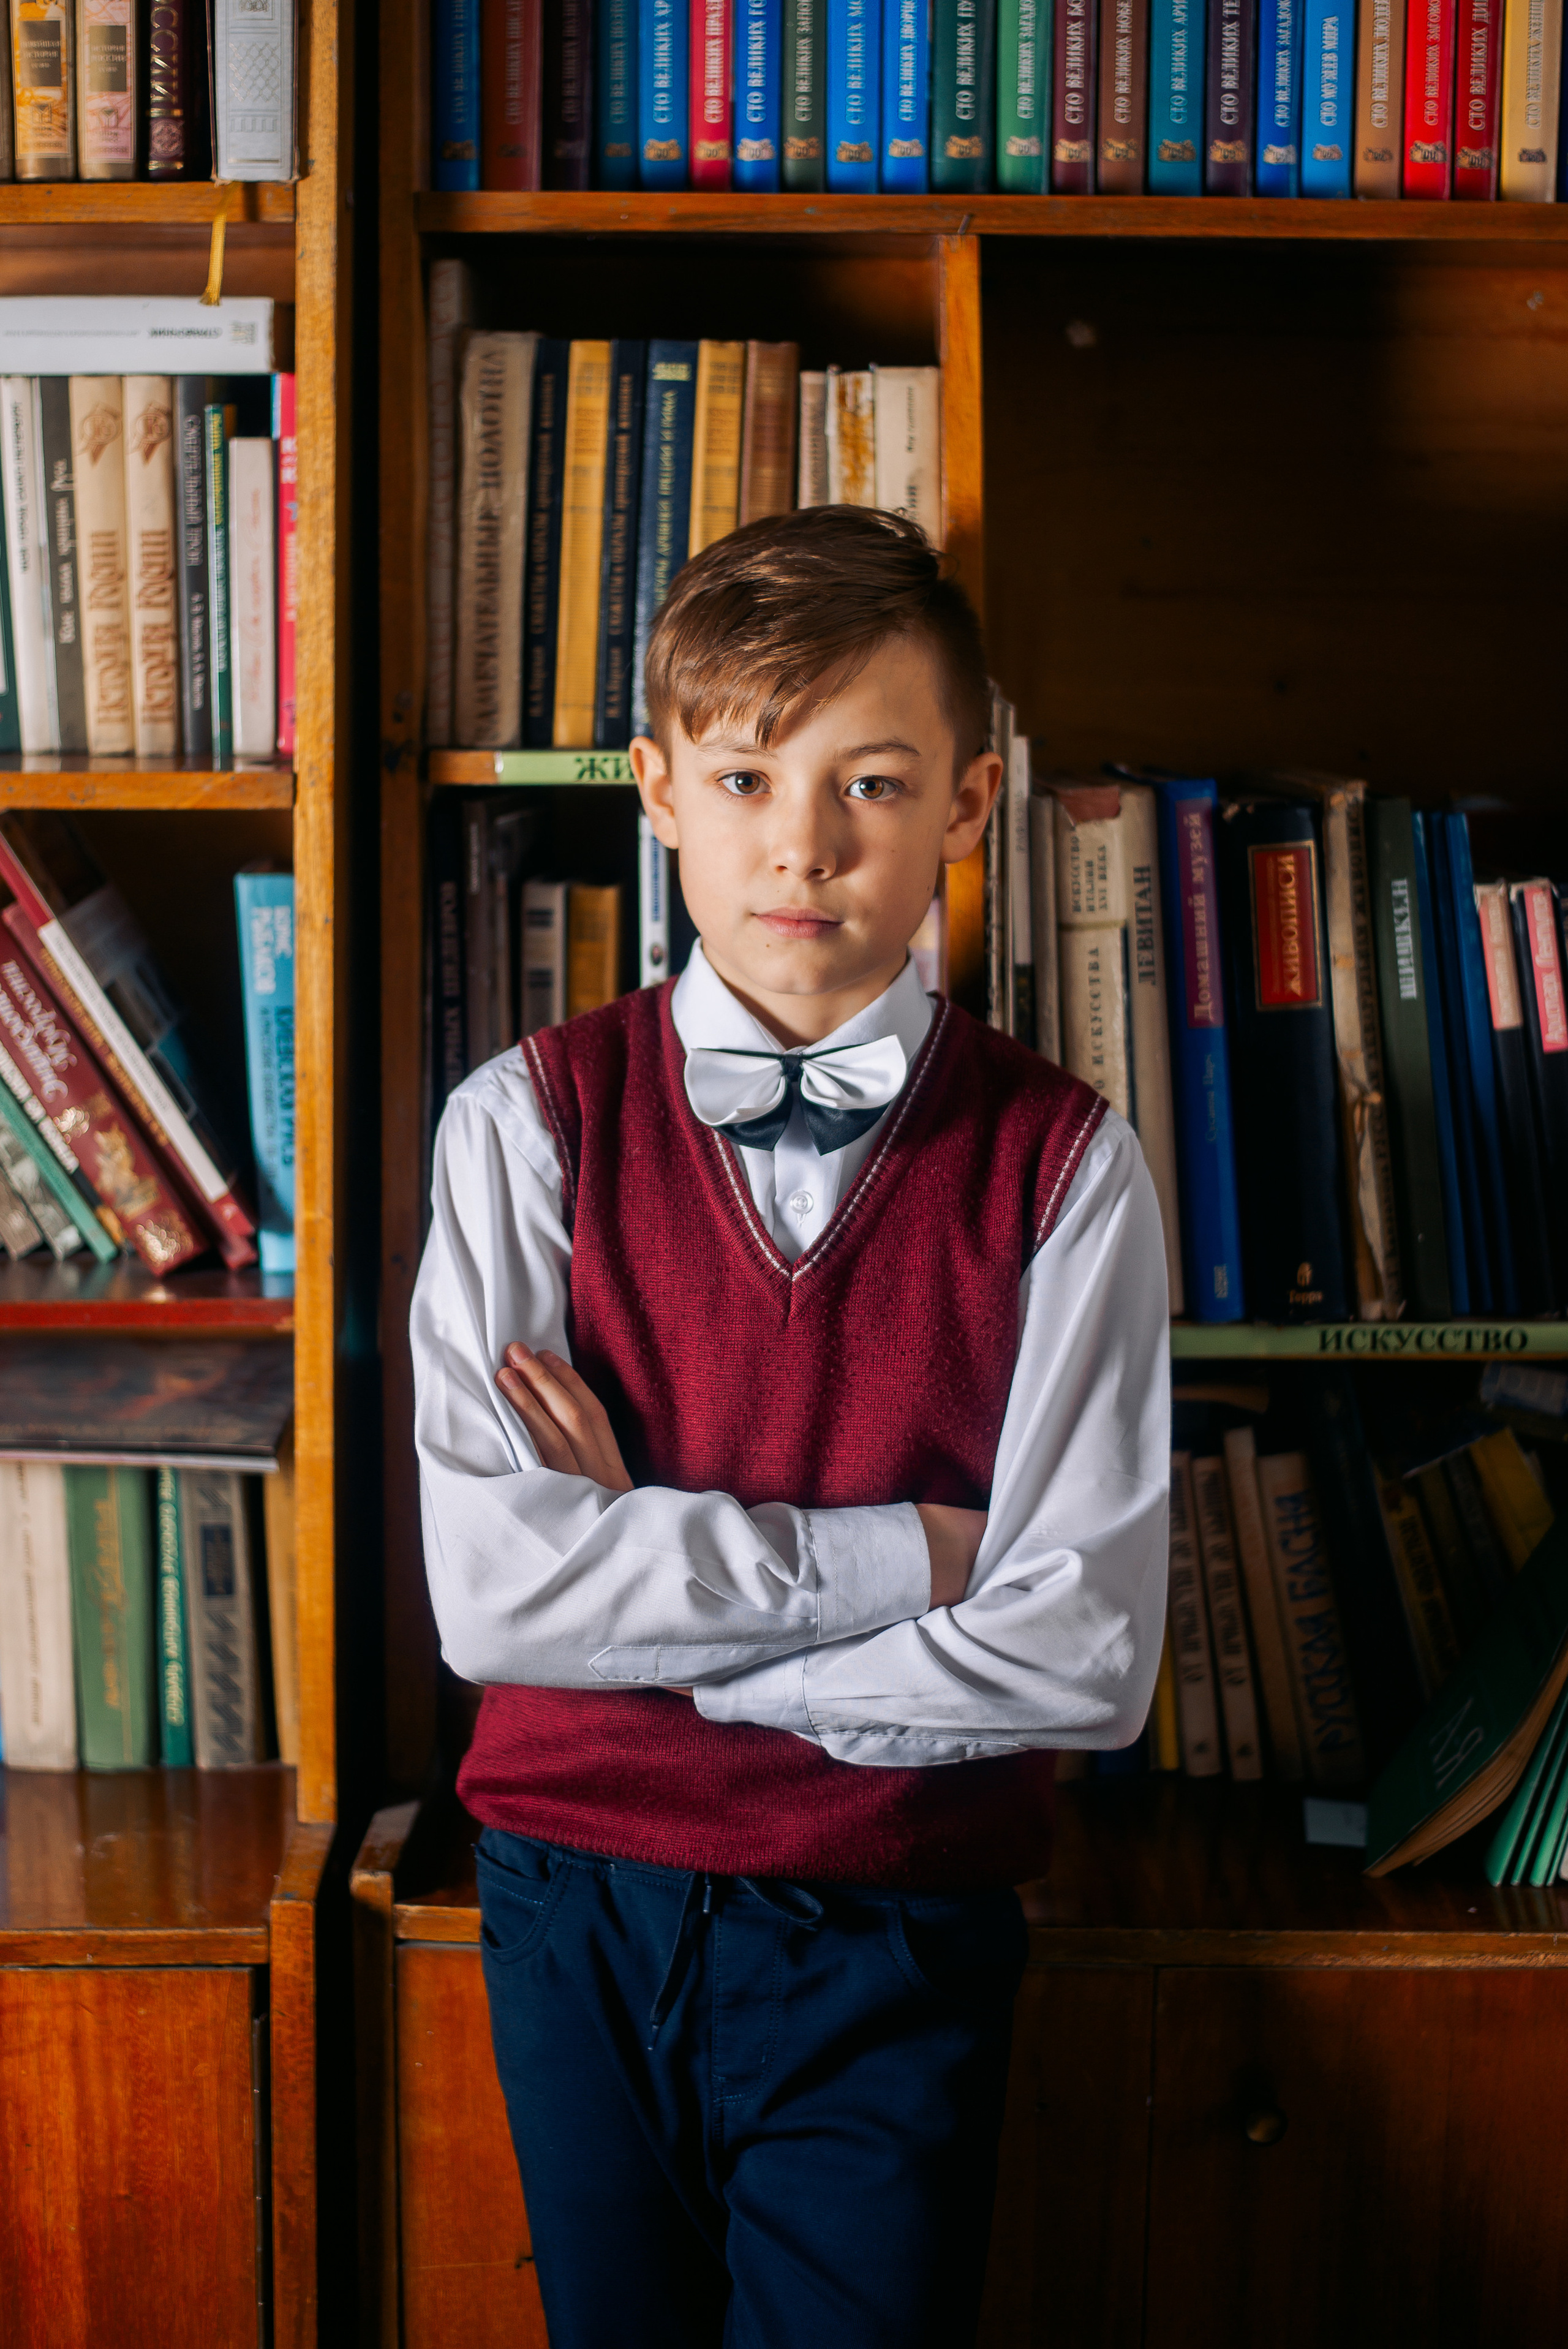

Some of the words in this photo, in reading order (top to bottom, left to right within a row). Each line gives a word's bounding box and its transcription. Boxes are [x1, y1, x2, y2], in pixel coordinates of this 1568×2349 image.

[653, 23, 673, 88] ВЕЛИКИХ
[746, 21, 767, 87] ВЕЛИКИХ
[845, 22, 865, 89] ВЕЛИКИХ
[955, 23, 976, 86] ВЕЛИКИХ
[1064, 21, 1085, 88] ВЕЛИКИХ
[1169, 29, 1188, 91] ВЕЛИКИХ
[1220, 21, 1240, 89] ВЕЛИКИХ
[1321, 15, 1339, 51] МИРА
[704, 37, 724, 97] ВЕЛИКИХ
[794, 37, 813, 92] ВЕЛИКИХ
[898, 43, 918, 97] ВЕЛИКИХ
[1016, 41, 1036, 95] ВЕЛИКИХ
[1114, 36, 1133, 94] ВЕЛИКИХ
[1273, 48, 1292, 103] ВЕЛИКИХ
[1320, 52, 1339, 99] МУЗЕЕВ
[1371, 40, 1390, 101] ВЕЛИКИХ
[1424, 43, 1441, 98] ВЕЛИКИХ
[1468, 27, 1488, 96] ВЕЛИКИХ
[1525, 43, 1544, 102] ВЕЛИКИХ
[653, 91, 673, 123] СТО
[704, 97, 724, 123] СТО
[746, 91, 767, 123] СТО
[794, 95, 813, 121] СТО
[845, 93, 865, 125] СТО
[898, 99, 918, 122] СТО
[955, 90, 976, 120] СТО
[1016, 96, 1036, 119] СТО
[1064, 92, 1085, 124] СТО
[1114, 96, 1133, 124] СТО
[1169, 95, 1188, 124] СТО
[1220, 92, 1240, 124] СТО
[1273, 103, 1292, 127] СТО
[1319, 101, 1338, 127] СТО
[1371, 102, 1390, 127] СТО
[1424, 100, 1441, 126] СТО
[1468, 99, 1488, 130] СТО
[1525, 104, 1544, 129] СТО
[478, 349, 503, 489] ПОЛОТНА
[660, 389, 679, 428] РИМА
[657, 444, 676, 496] ГРЕЦИИ
[655, 500, 674, 557] ДРЕВНЕЙ
[1098, 845, 1107, 880] ВЕКА
[1185, 813, 1209, 883] музей
[1085, 860, 1095, 912] ИТАЛИИ
[1133, 867, 1156, 986] ЛЕВИТАН
[1277, 854, 1301, 997] ЖИВОПИСИ
[1392, 878, 1416, 999] ШИШКИН
[1188, 893, 1213, 1022] Домашний
[1088, 948, 1104, 1065] ИСКУССТВА
[1319, 1329, 1529, 1353] ИСКУССТВО
[1273, 1488, 1333, 1603] БАСНЯ
[1292, 1607, 1357, 1755] РУССКАЯ
